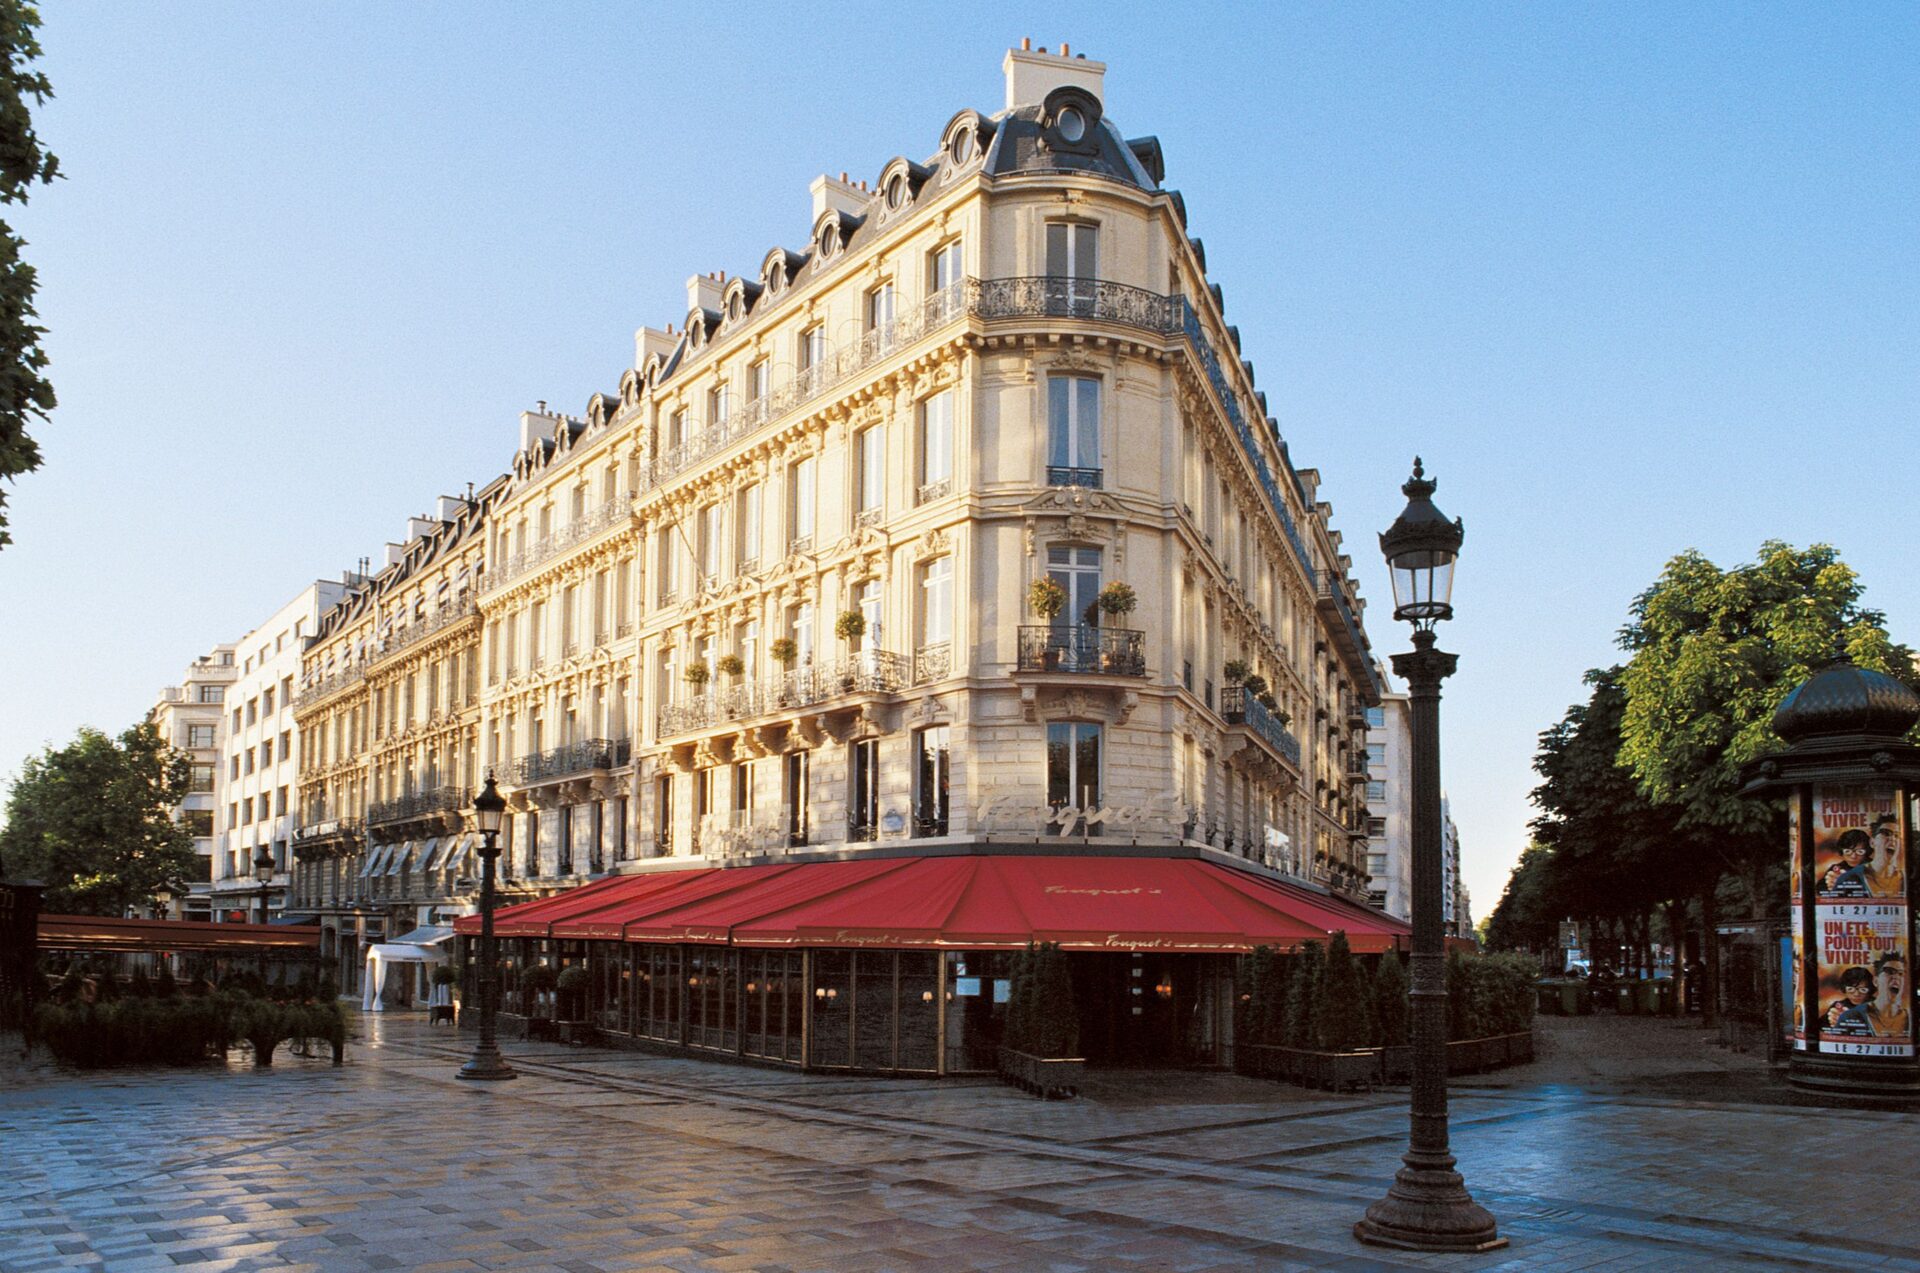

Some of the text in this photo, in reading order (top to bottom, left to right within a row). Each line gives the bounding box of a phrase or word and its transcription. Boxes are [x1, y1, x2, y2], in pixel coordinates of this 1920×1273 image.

[1822, 798, 1895, 814] POUR TOUT
[1822, 813, 1868, 828] VIVRE
[1832, 906, 1845, 915] LE
[1853, 906, 1868, 915] 27
[1824, 921, 1843, 935] UN
[1824, 936, 1897, 951] POUR TOUT
[1824, 950, 1871, 965] VIVRE
[1834, 1043, 1847, 1052] LE
[1855, 1044, 1870, 1053] 27
